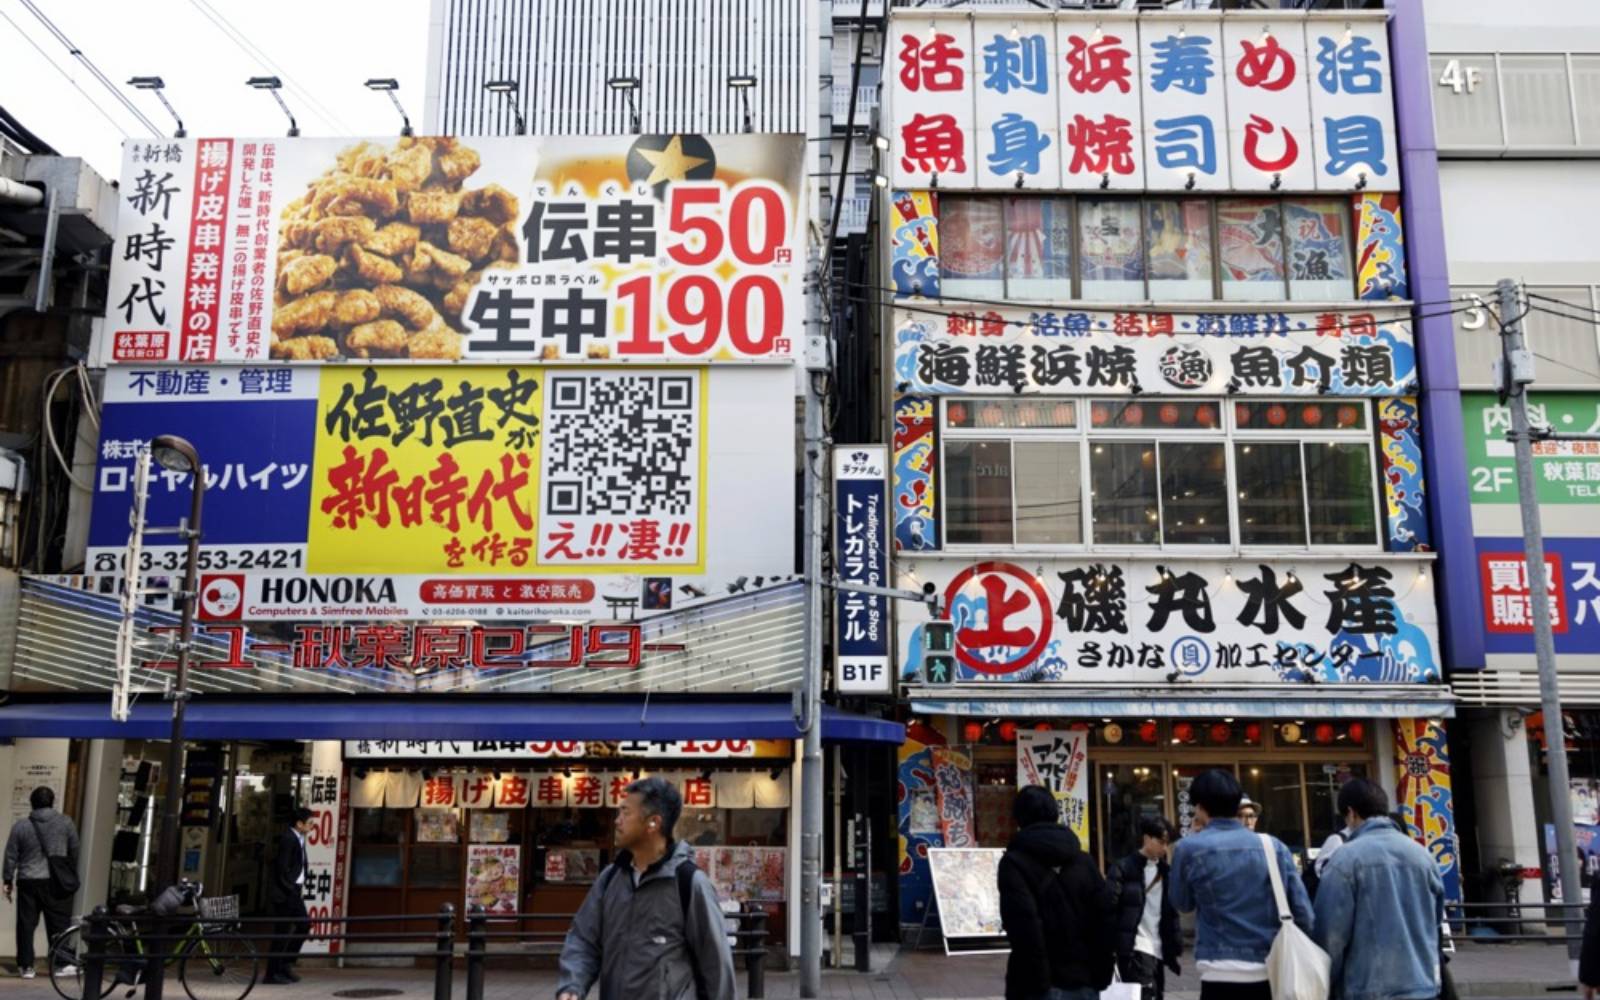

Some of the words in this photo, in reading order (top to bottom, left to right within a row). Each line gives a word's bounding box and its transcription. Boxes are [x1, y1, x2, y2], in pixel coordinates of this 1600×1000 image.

[1439, 60, 1482, 93] 4F
[899, 34, 967, 174] 活魚
[983, 34, 1051, 176] 刺身
[1066, 34, 1136, 175] 浜焼
[1150, 35, 1217, 175] 寿司
[1236, 35, 1299, 172] めし
[1317, 36, 1388, 177] 活貝
[536, 186, 647, 197] でんぐし
[116, 169, 181, 326] 新時代
[183, 141, 229, 361] 揚げ皮串発祥の店
[522, 199, 657, 264] 伝串
[487, 274, 601, 287] サッポロ黒ラベル
[118, 333, 165, 348] 秋葉原
[468, 288, 608, 354] 生中
[128, 369, 293, 396] 不動産・管理
[917, 344, 1138, 386] 海鮮浜焼
[1230, 345, 1394, 387] 魚介類
[320, 444, 534, 533] 新時代
[1471, 467, 1513, 492] 2F
[443, 536, 534, 569] を作る
[248, 606, 306, 617] Computers
[311, 606, 318, 616] &
[321, 606, 362, 616] Simfree
[365, 606, 409, 616] Mobiles
[261, 577, 397, 604] HONOKA
[1056, 563, 1398, 635] 磯丸水産
[867, 610, 880, 642] Shop
[843, 664, 882, 681] B1F
[311, 775, 337, 804] 伝串
[425, 776, 711, 806] 揚げ皮串発店
